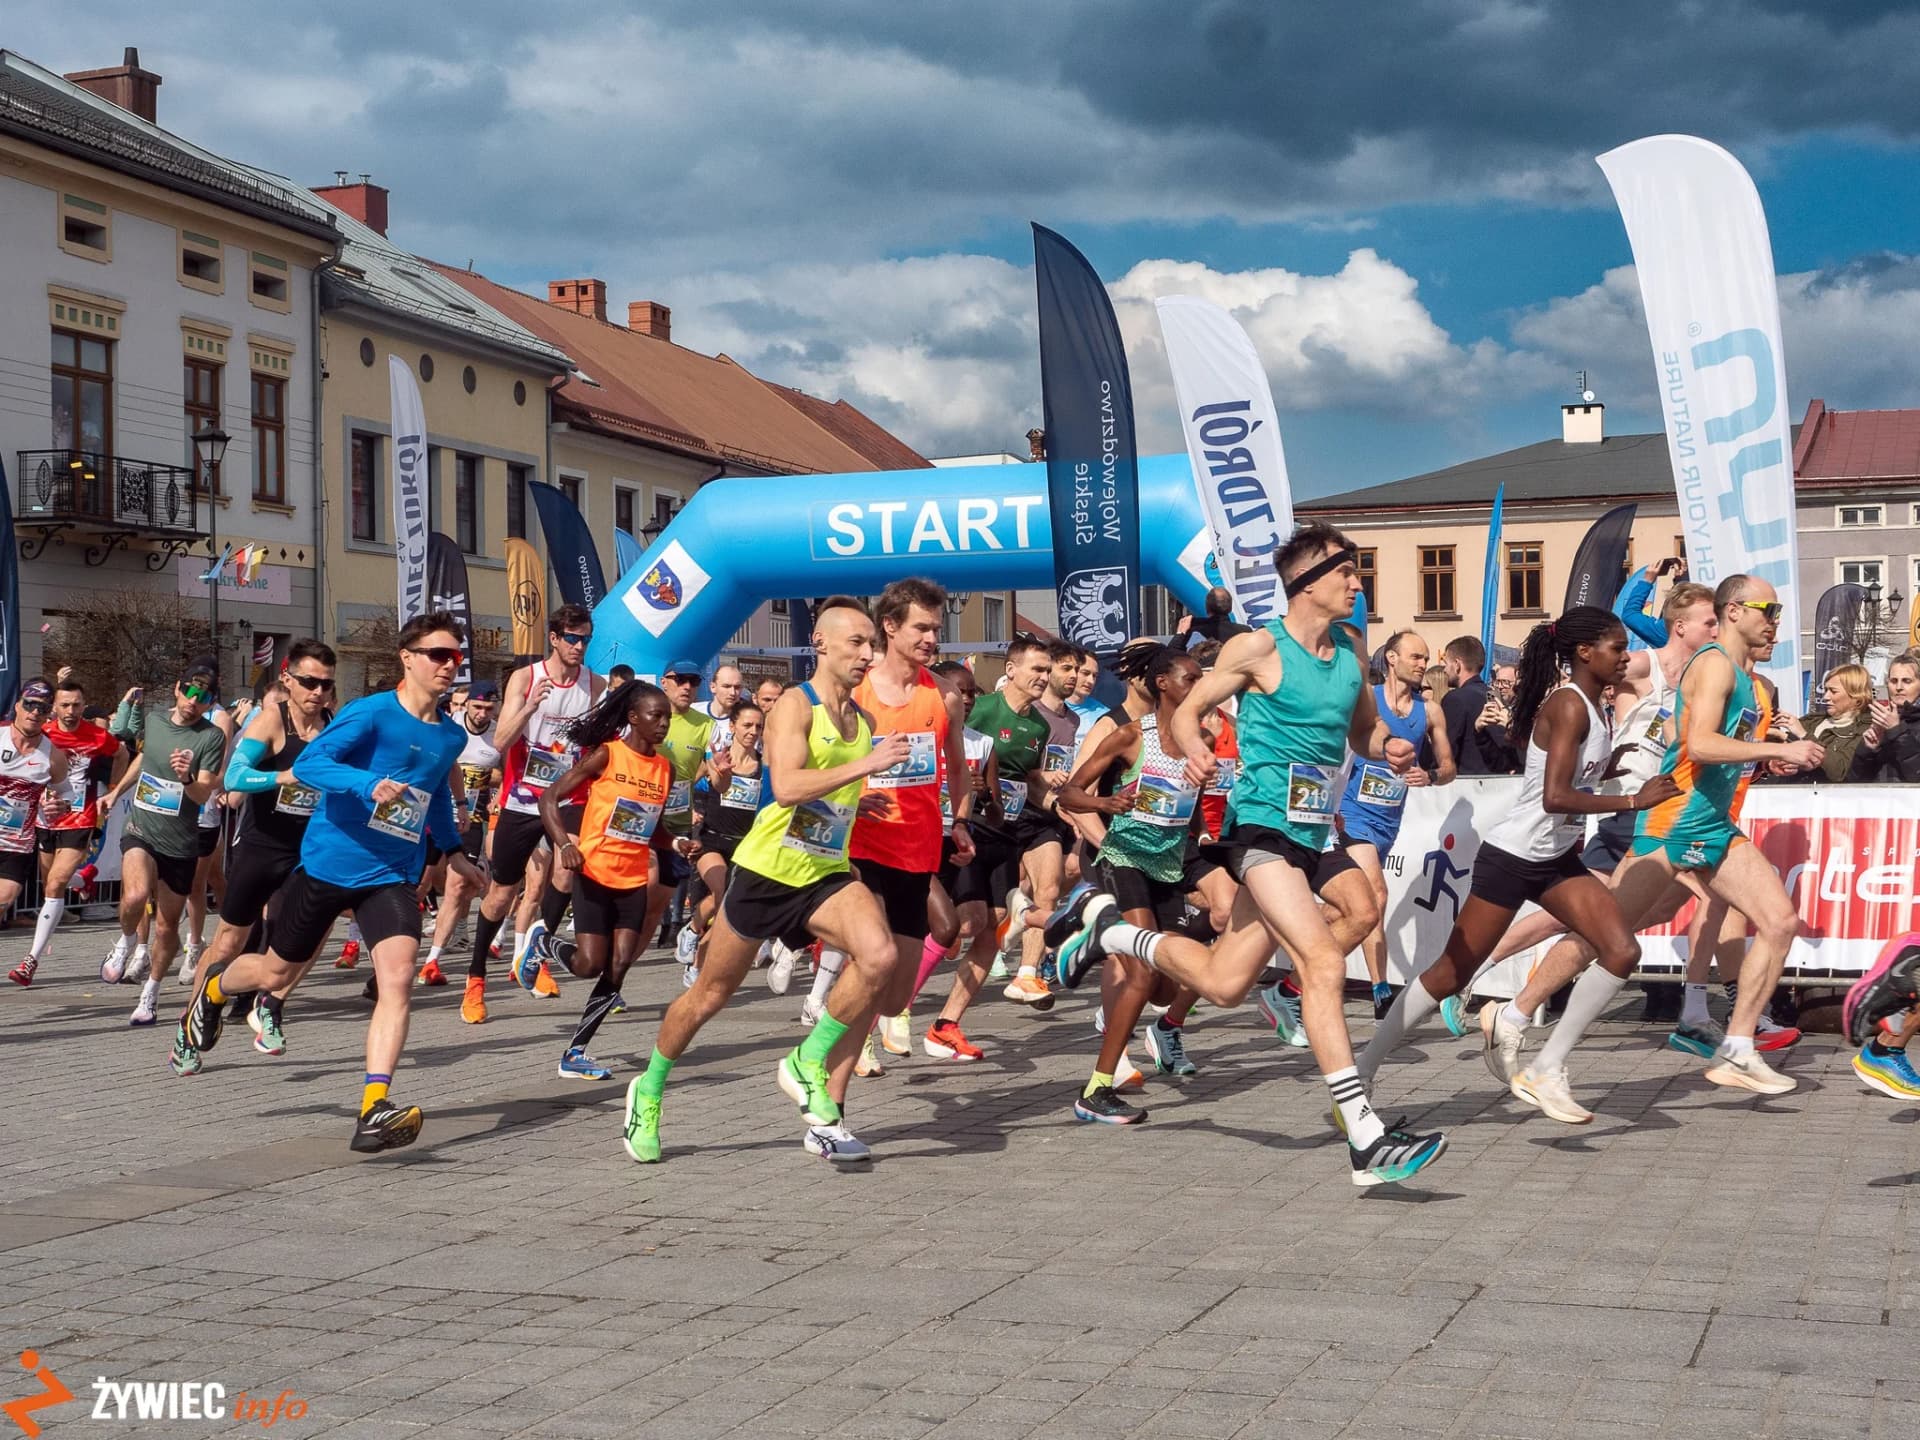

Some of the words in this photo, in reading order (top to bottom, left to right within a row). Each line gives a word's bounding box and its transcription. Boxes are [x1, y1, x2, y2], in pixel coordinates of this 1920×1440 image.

[826, 495, 1044, 557] START
[1296, 787, 1329, 809] 219
[1367, 781, 1402, 798] 1367
[387, 804, 420, 828] 299
[1156, 796, 1178, 815] 11
[627, 817, 647, 833] 13
[810, 822, 834, 844] 16
